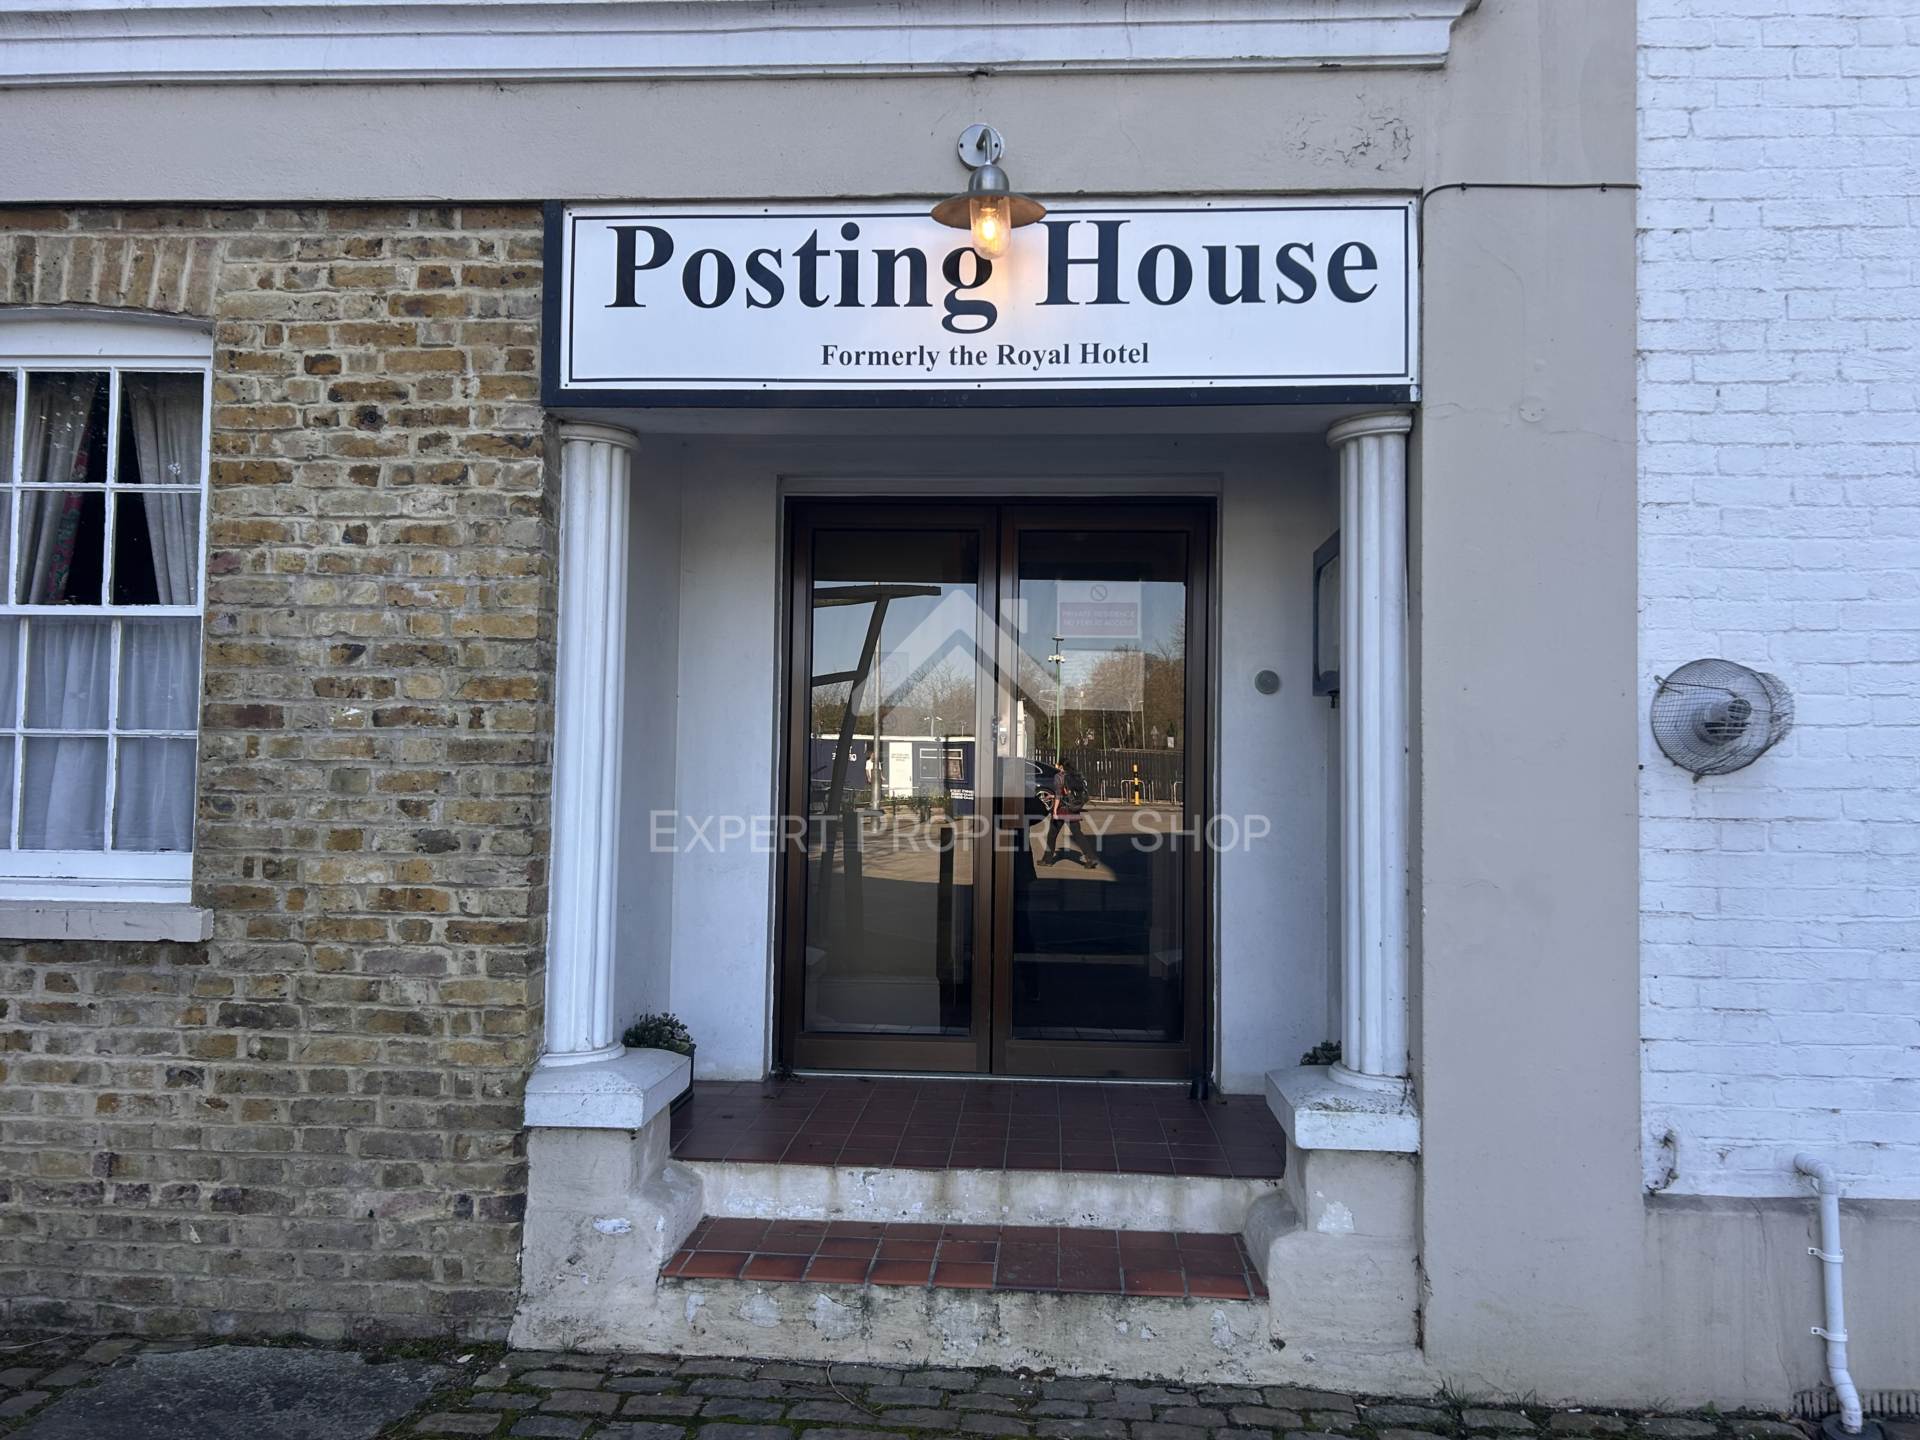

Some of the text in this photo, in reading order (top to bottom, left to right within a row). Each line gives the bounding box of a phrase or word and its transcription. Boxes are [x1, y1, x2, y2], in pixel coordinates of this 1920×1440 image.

[604, 219, 1379, 335] Posting House
[822, 342, 1149, 372] Formerly the Royal Hotel
